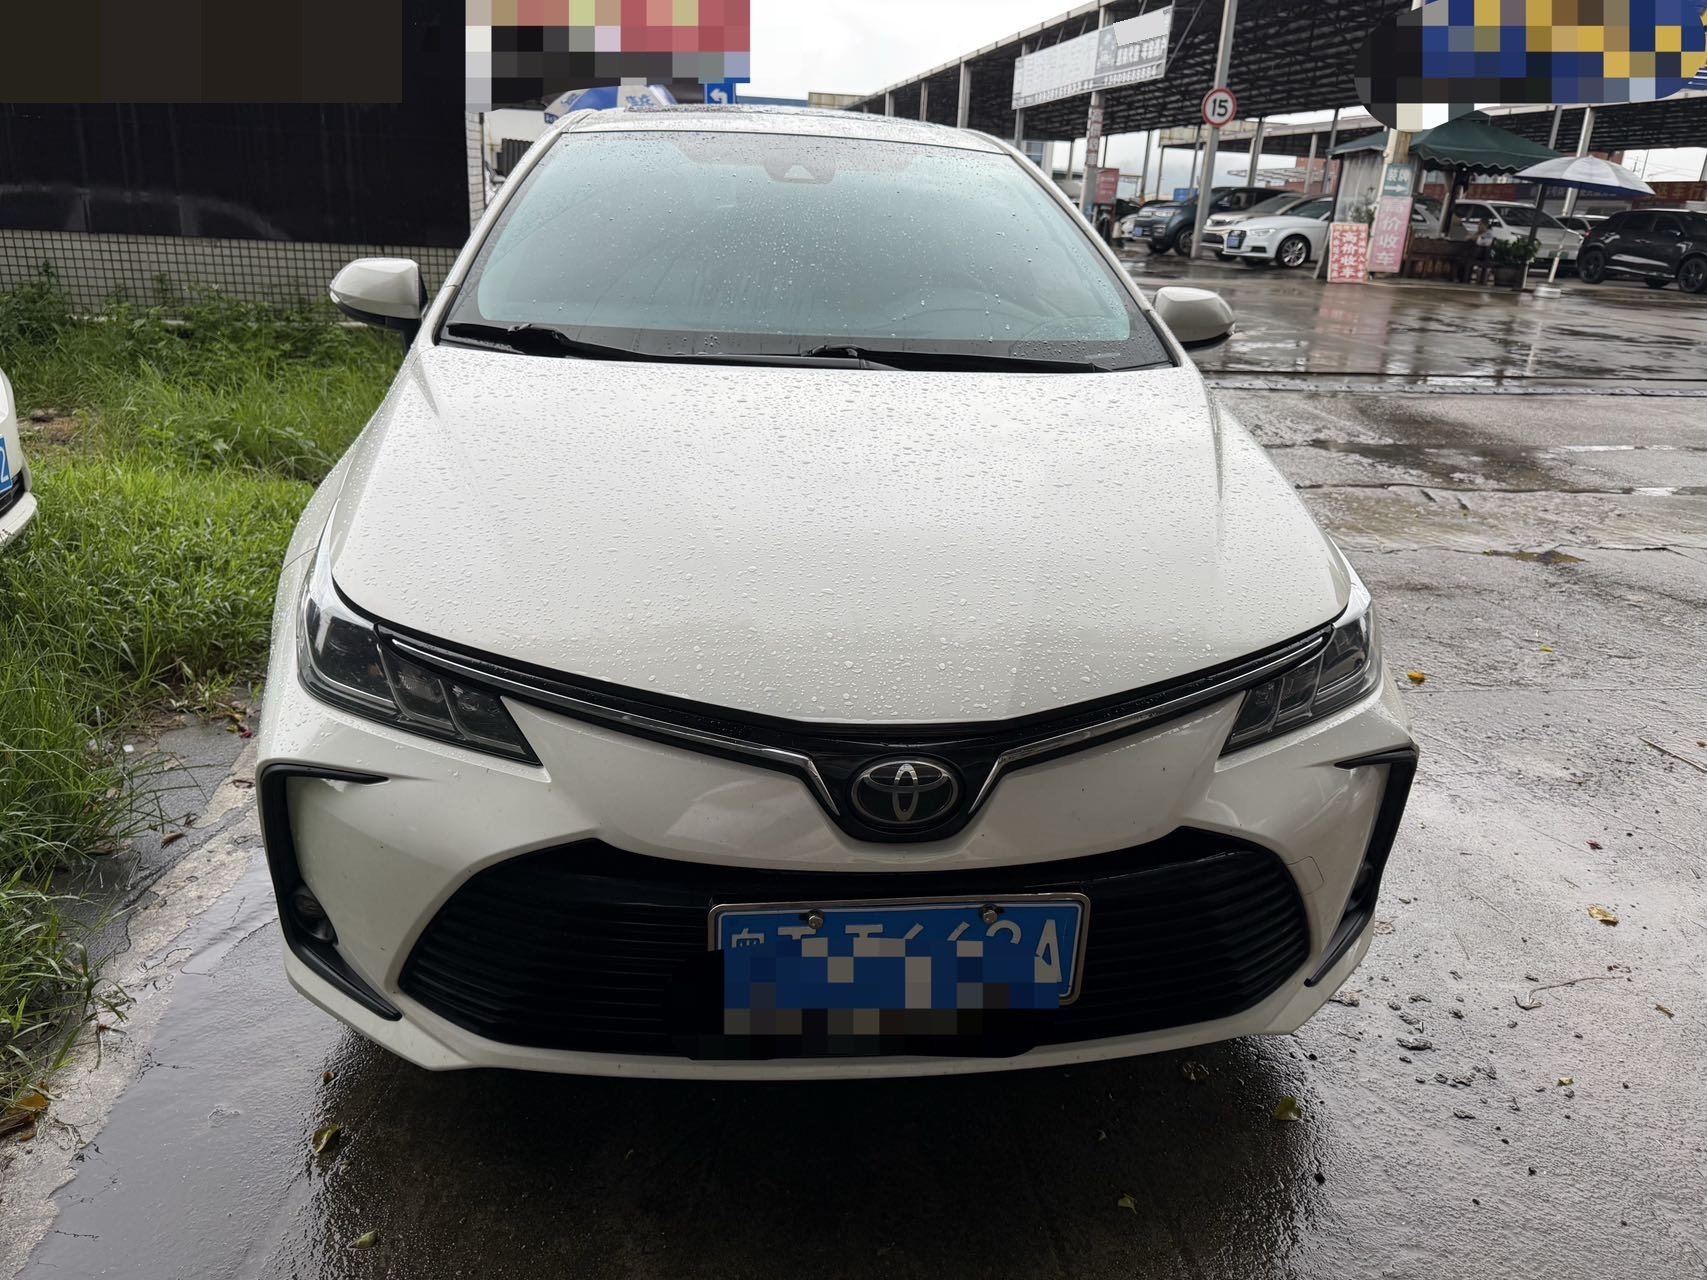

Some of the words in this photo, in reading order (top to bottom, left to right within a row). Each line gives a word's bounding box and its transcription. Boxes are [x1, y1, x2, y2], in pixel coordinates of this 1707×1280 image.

[1212, 98, 1228, 117] 15
[1387, 167, 1410, 182] 装牌
[1376, 200, 1403, 266] 高价收车
[1340, 231, 1358, 278] 高价收车
